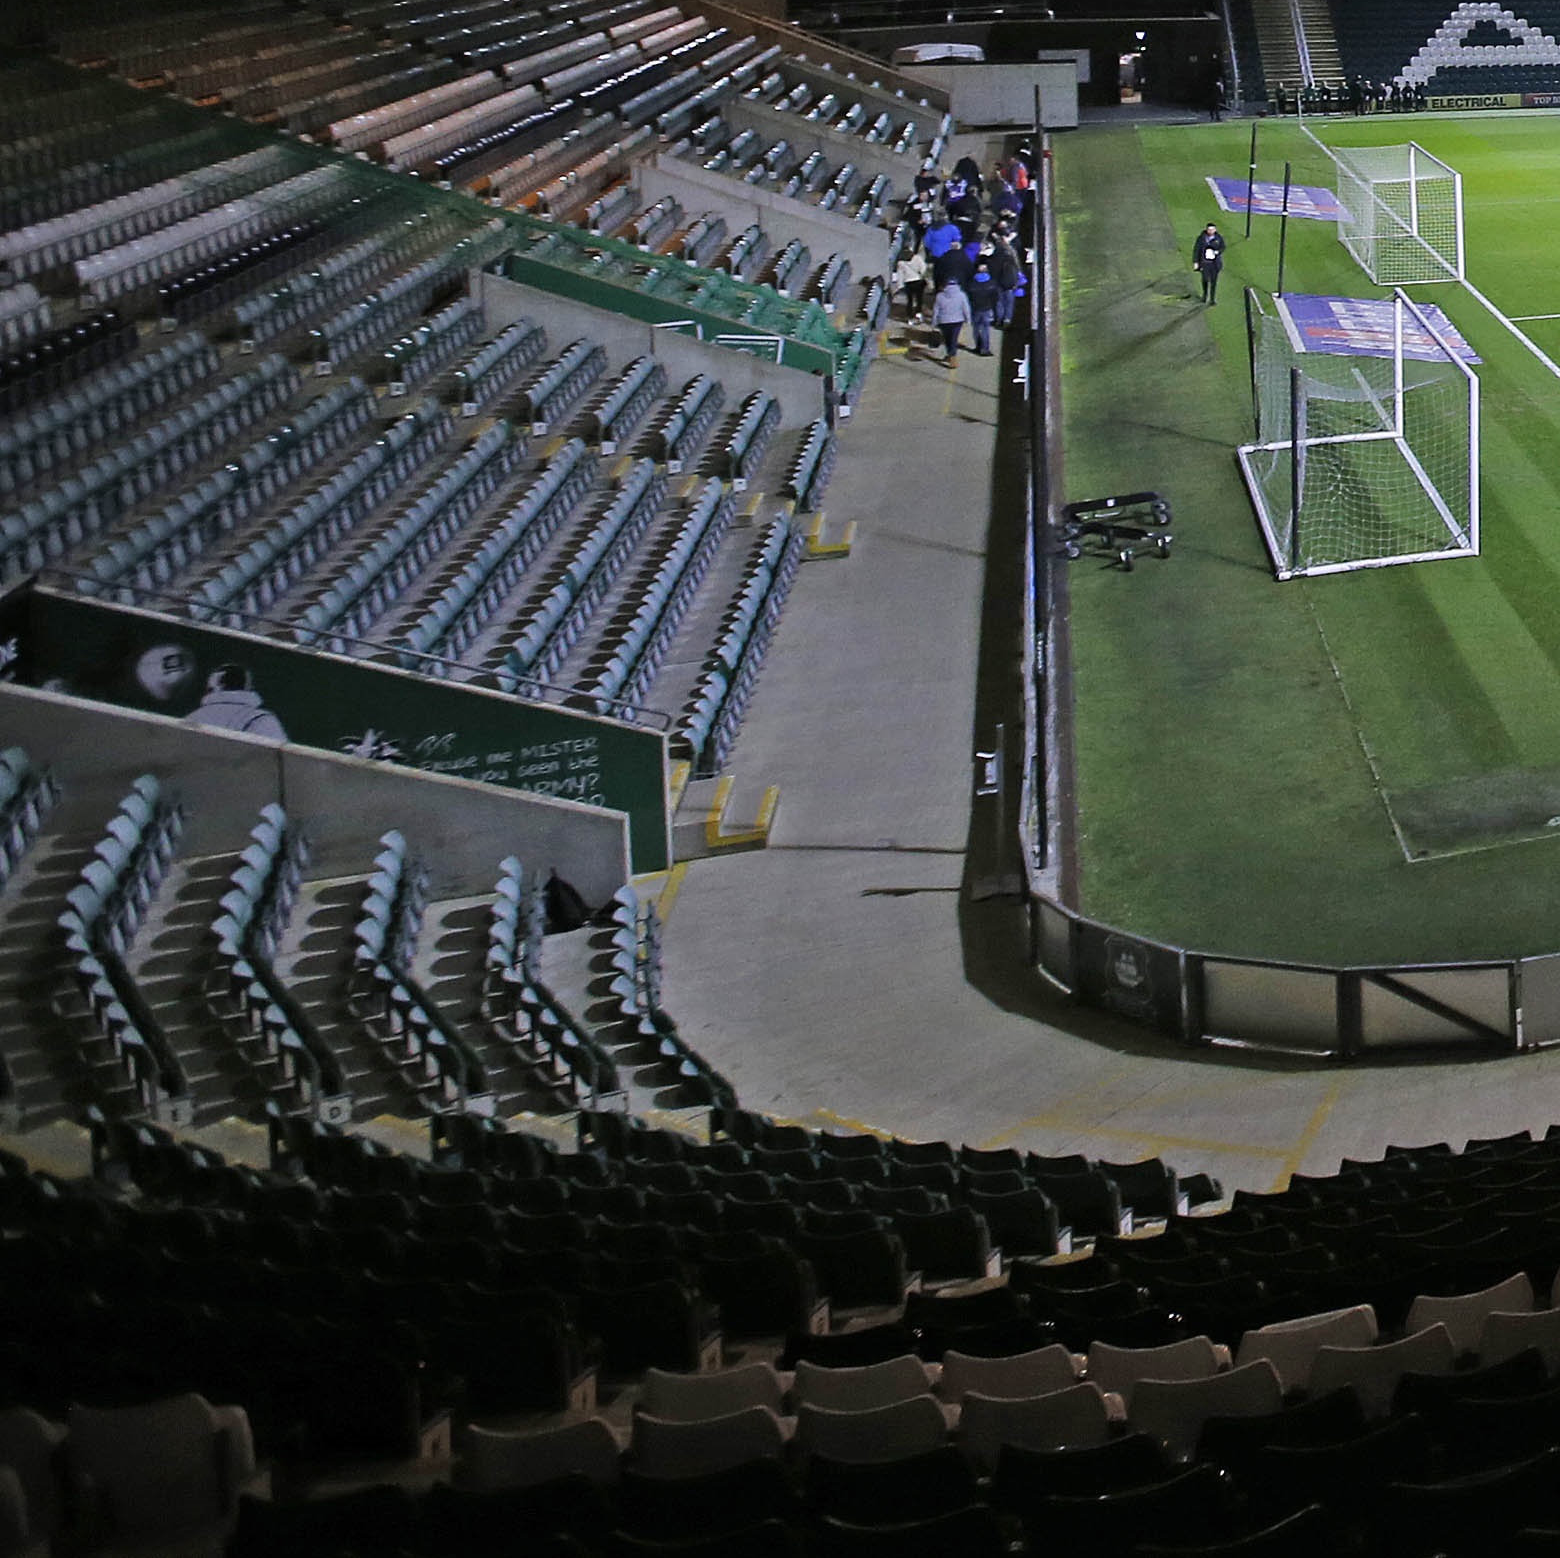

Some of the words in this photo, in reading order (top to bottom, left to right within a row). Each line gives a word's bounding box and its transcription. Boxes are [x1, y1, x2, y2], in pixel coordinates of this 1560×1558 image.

[1431, 96, 1507, 109] ELECTRICAL
[520, 737, 599, 758] MISTER
[517, 760, 560, 778] seen
[567, 754, 599, 770] the
